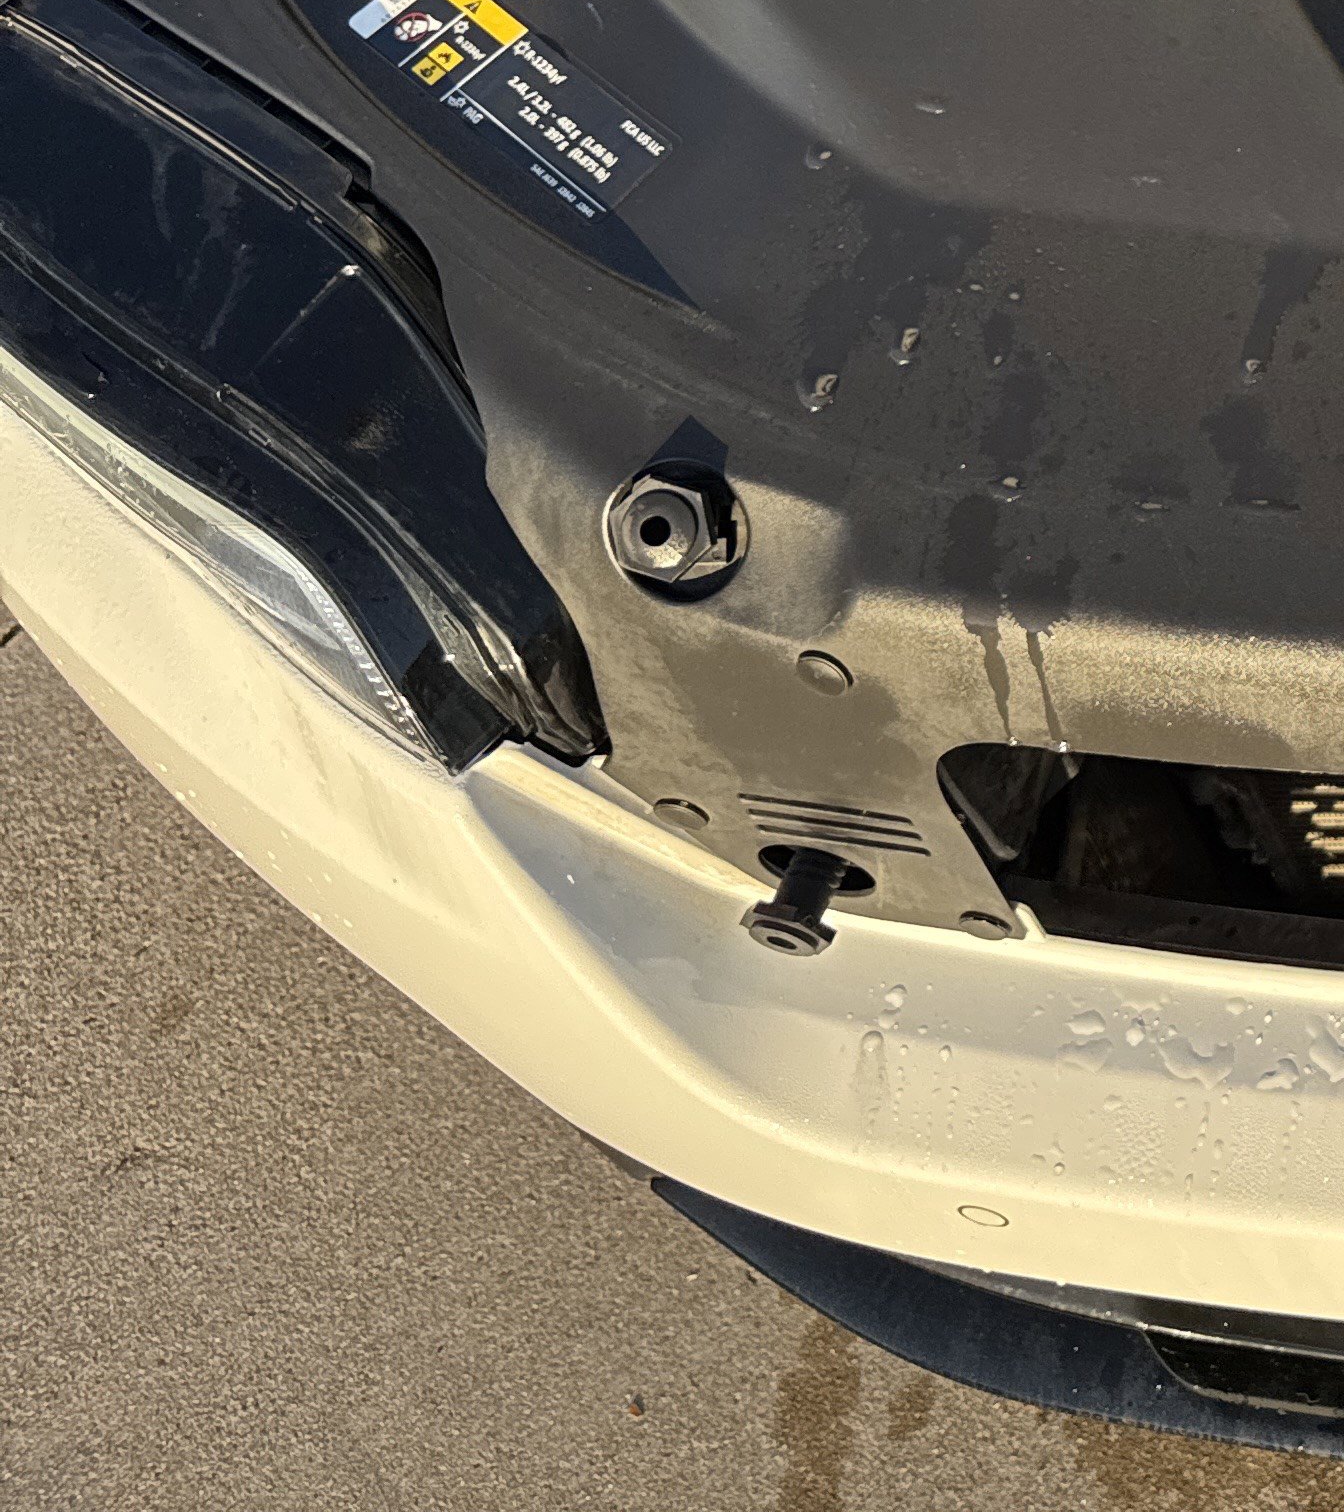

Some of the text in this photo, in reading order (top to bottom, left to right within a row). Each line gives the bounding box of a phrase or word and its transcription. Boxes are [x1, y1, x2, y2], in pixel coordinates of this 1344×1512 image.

[463, 106, 484, 124] PAG
[620, 119, 665, 157] FCA US LLC
